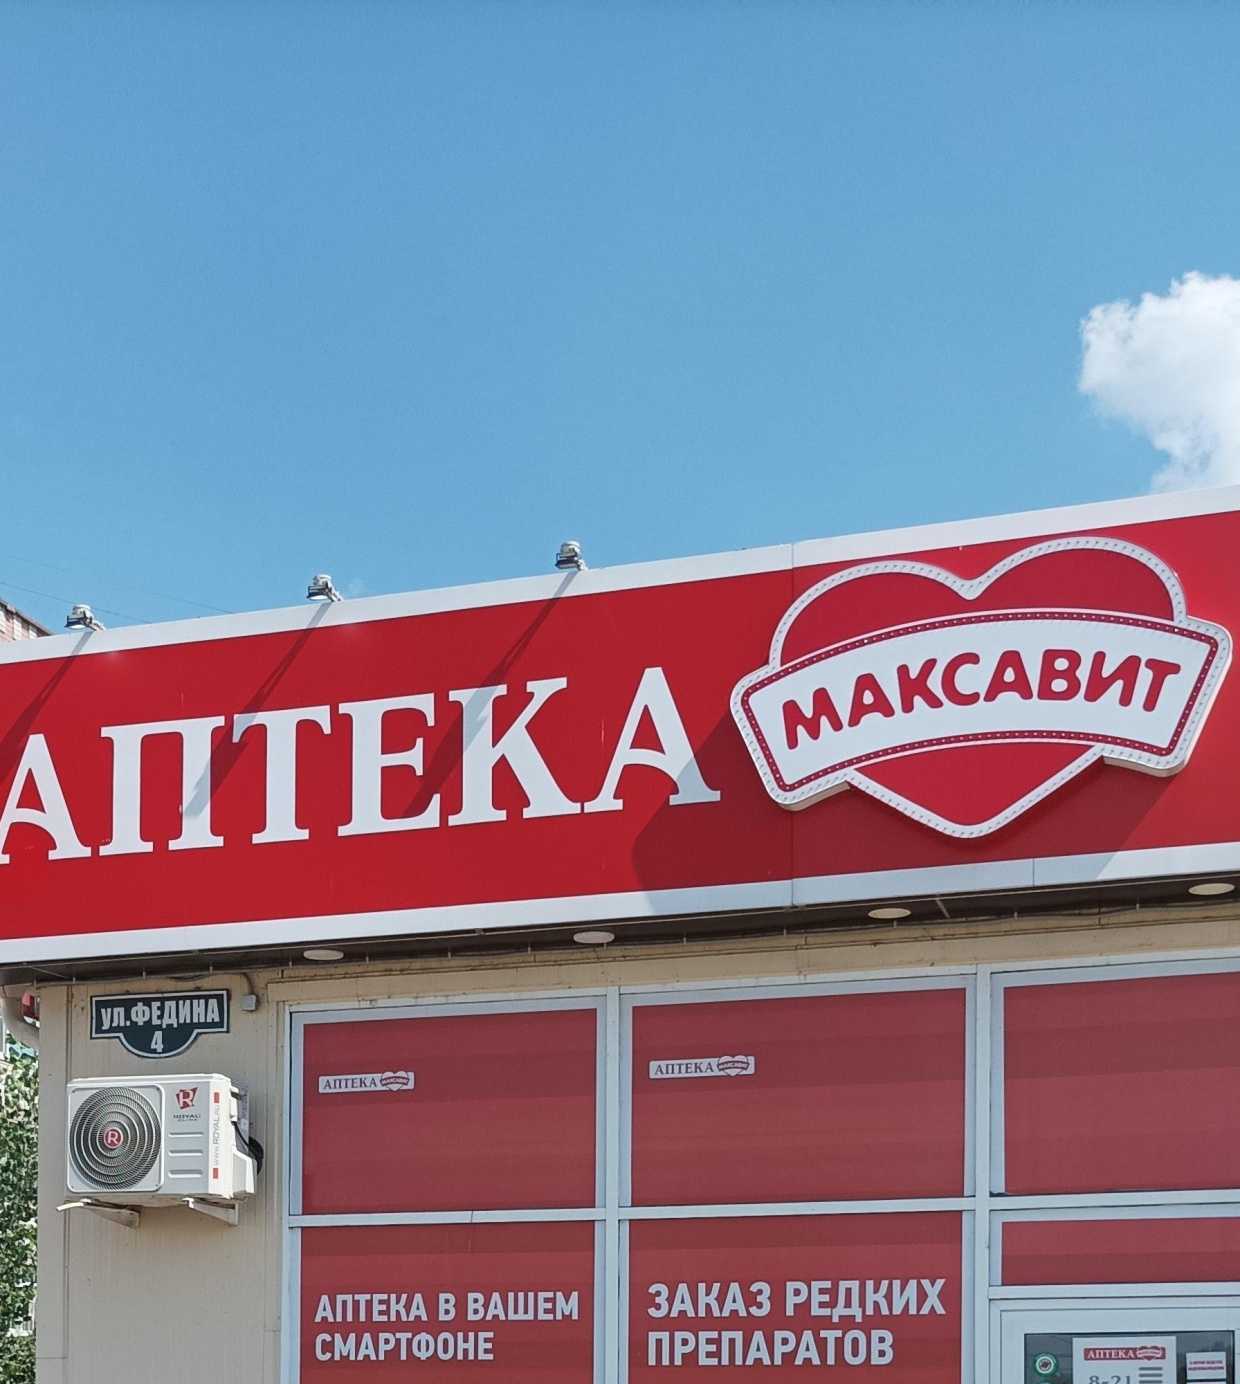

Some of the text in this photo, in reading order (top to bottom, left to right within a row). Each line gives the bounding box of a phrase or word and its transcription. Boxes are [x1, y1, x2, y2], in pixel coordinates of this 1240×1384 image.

[781, 648, 1182, 751] МАКСАВИТ
[0, 667, 721, 865] АПТЕКА
[151, 1030, 164, 1053] 4
[323, 1077, 378, 1090] АПТЕКА
[653, 1062, 715, 1075] АПТЕКА
[314, 1291, 579, 1323] АПТЕКА В ВАШЕМ
[647, 1278, 946, 1323] ЗАКАЗ РЕДКИХ
[314, 1331, 494, 1361] СМАРТФОНЕ
[647, 1329, 894, 1367] ПРЕПАРАТОВ
[1087, 1349, 1135, 1359] АПТЕКА
